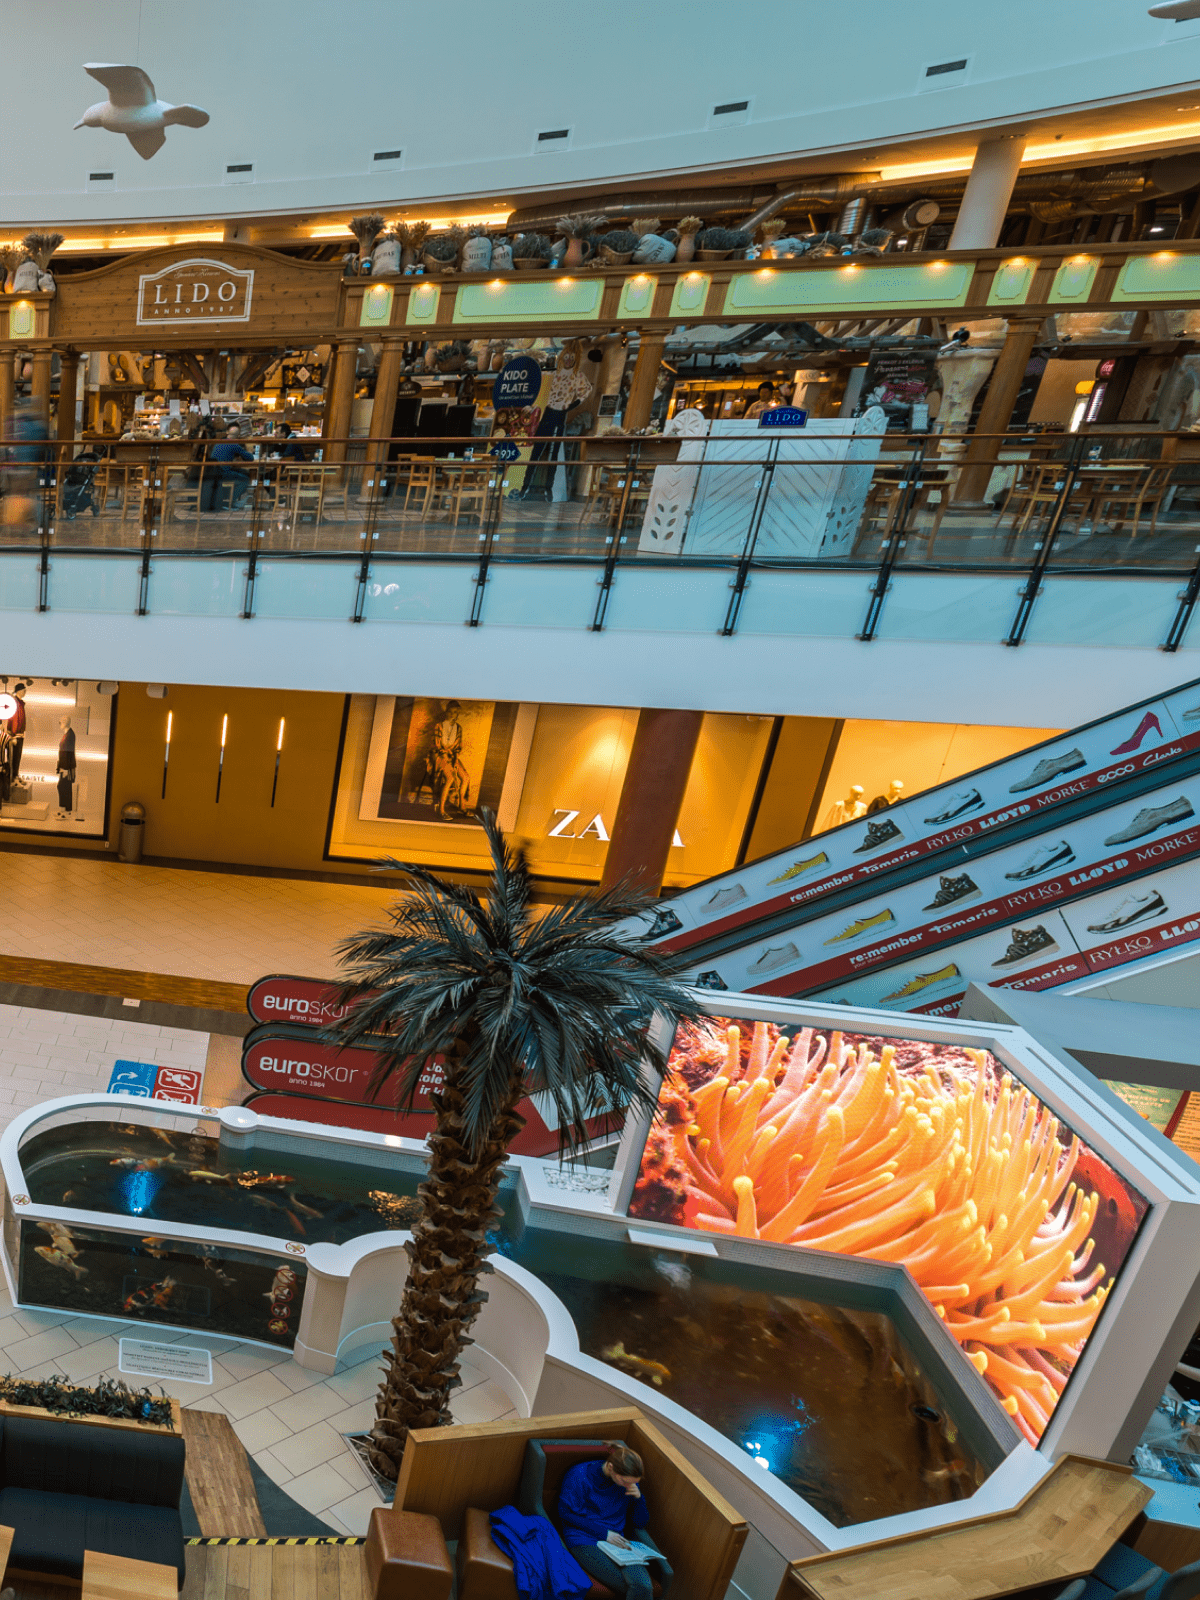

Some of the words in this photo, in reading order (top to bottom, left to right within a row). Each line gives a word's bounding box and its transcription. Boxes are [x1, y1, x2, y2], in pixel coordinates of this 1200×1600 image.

[154, 281, 237, 304] LIDO
[503, 369, 528, 381] KIDO
[500, 382, 529, 393] PLATE
[767, 413, 801, 422] LIDO
[790, 873, 854, 903] re:member
[979, 804, 1031, 829] LLOYD
[1036, 781, 1090, 807] MORKE
[1097, 763, 1135, 783] ecco
[1142, 746, 1182, 766] Clarks
[849, 932, 924, 965] re:member
[1007, 882, 1062, 908] RYŁKO
[1068, 858, 1129, 886] LLOYD
[1090, 936, 1151, 963] RYŁKO
[1160, 919, 1200, 940] LLO
[288, 1077, 307, 1086] anno
[419, 1084, 431, 1095] ir
